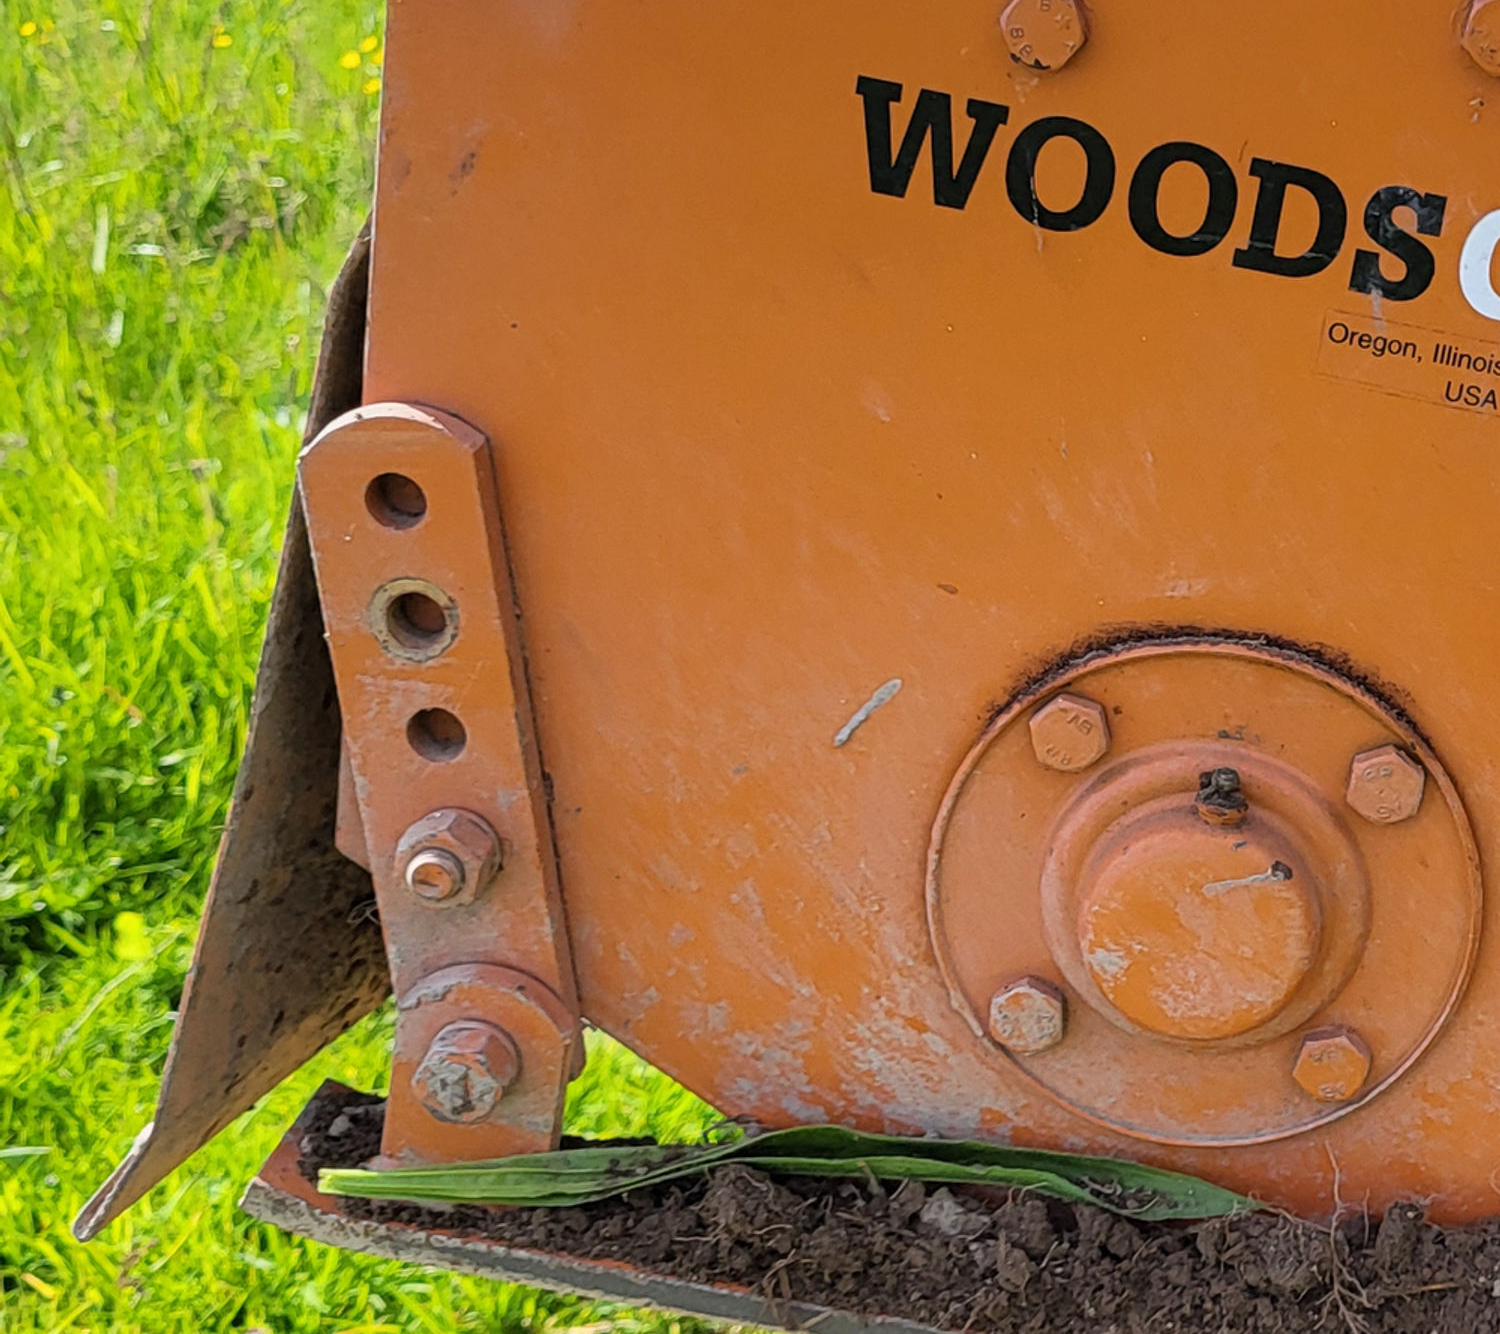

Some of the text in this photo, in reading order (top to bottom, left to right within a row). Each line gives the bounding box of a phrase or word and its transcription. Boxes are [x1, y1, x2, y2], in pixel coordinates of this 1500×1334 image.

[855, 75, 1448, 302] WOODS
[1328, 322, 1423, 363] Oregon,
[1444, 380, 1498, 410] USA
